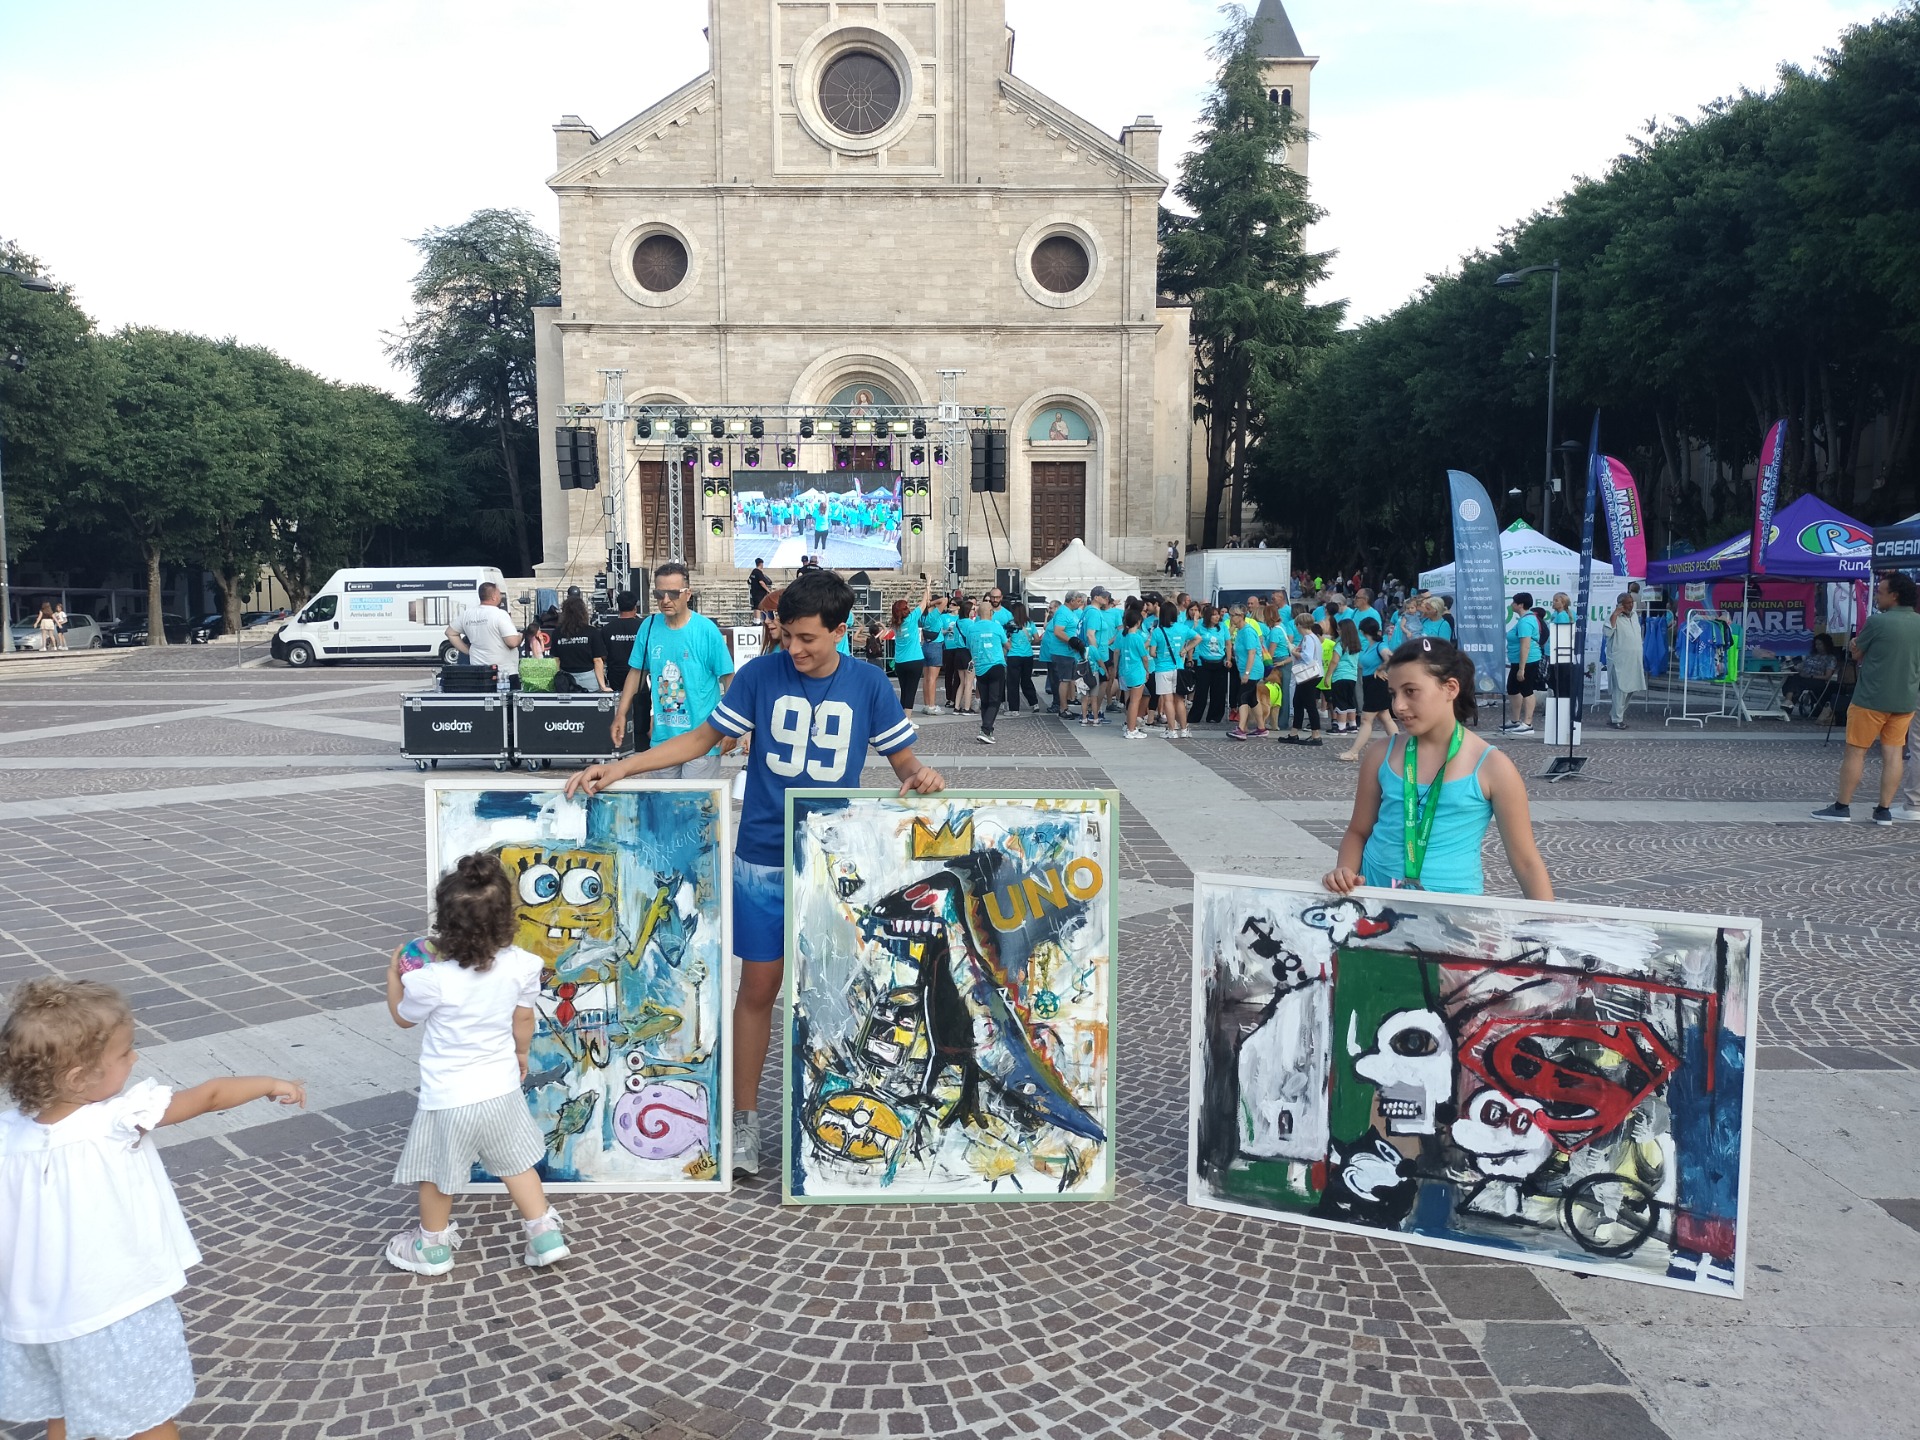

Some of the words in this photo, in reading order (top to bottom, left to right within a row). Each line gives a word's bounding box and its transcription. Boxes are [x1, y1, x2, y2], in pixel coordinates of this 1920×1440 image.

[1759, 465, 1771, 521] MARE
[1614, 488, 1635, 539] MARE
[1513, 548, 1573, 557] Stornelli
[1668, 562, 1695, 574] RUNNERS
[1696, 559, 1722, 571] PESCARA
[1503, 574, 1560, 586] tornelli
[1787, 600, 1806, 609] DEL
[1727, 610, 1804, 631] MARE
[765, 694, 853, 782] 99
[983, 856, 1103, 933] UNO
